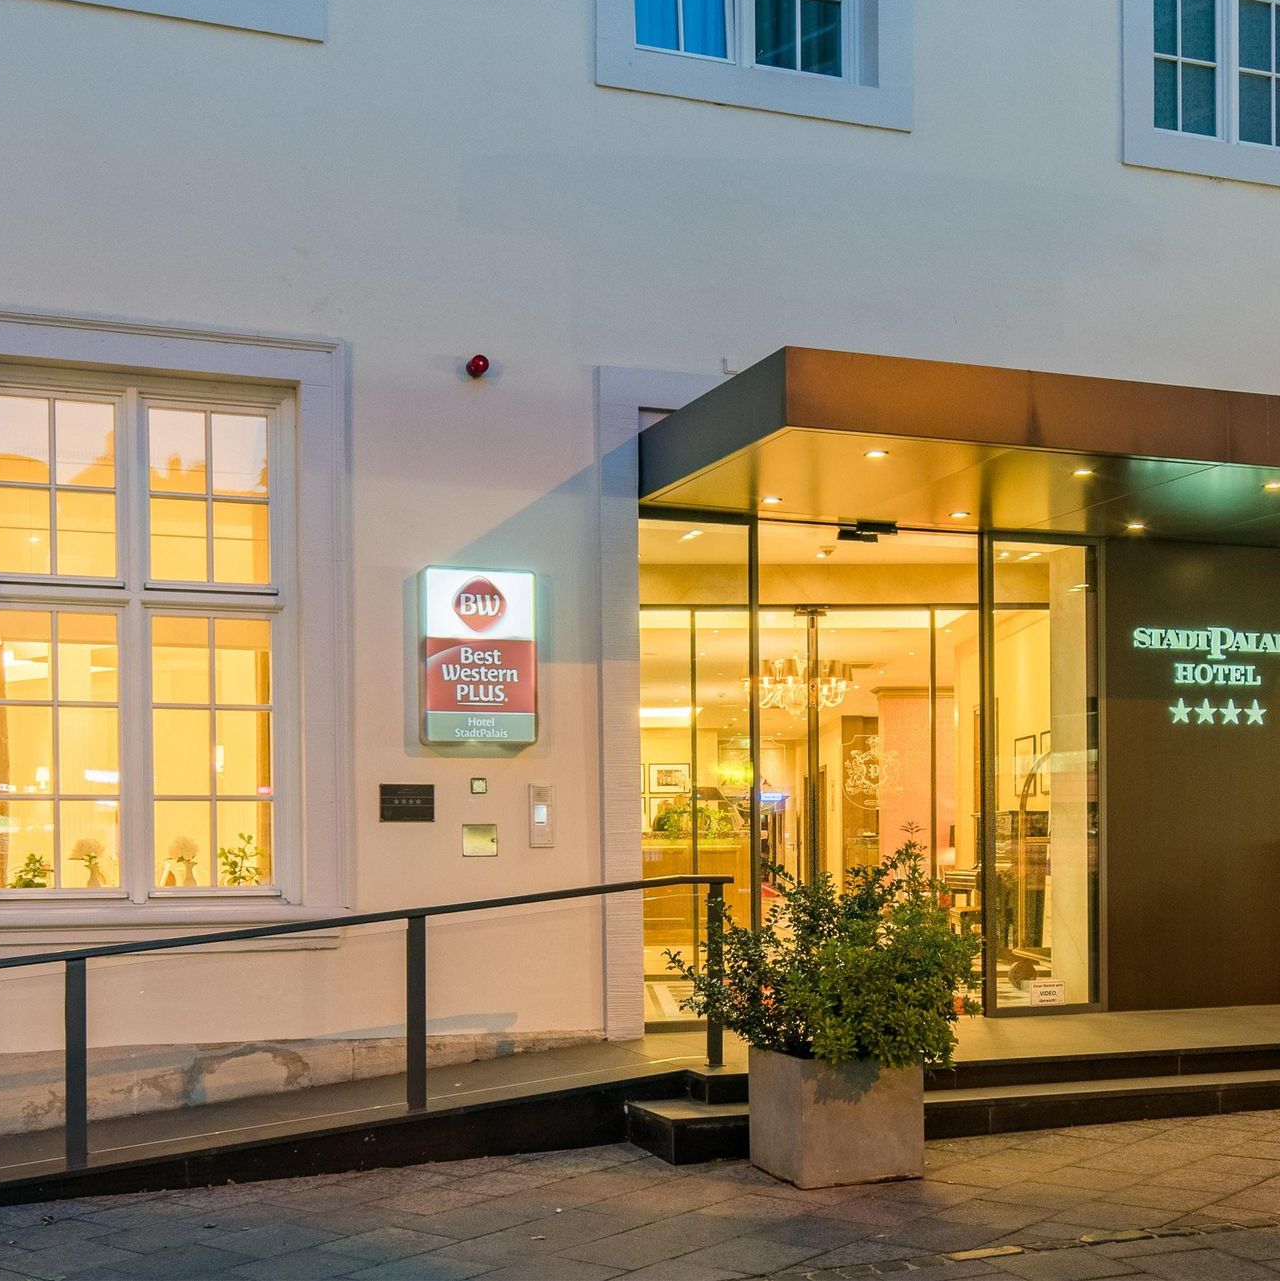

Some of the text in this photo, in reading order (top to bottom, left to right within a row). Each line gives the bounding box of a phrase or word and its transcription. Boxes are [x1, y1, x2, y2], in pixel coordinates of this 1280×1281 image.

[459, 592, 501, 617] BW
[459, 646, 502, 665] Best
[441, 663, 519, 683] Western
[1173, 662, 1262, 686] HOTEL
[467, 717, 495, 727] Hotel
[454, 727, 509, 739] StadtPalais
